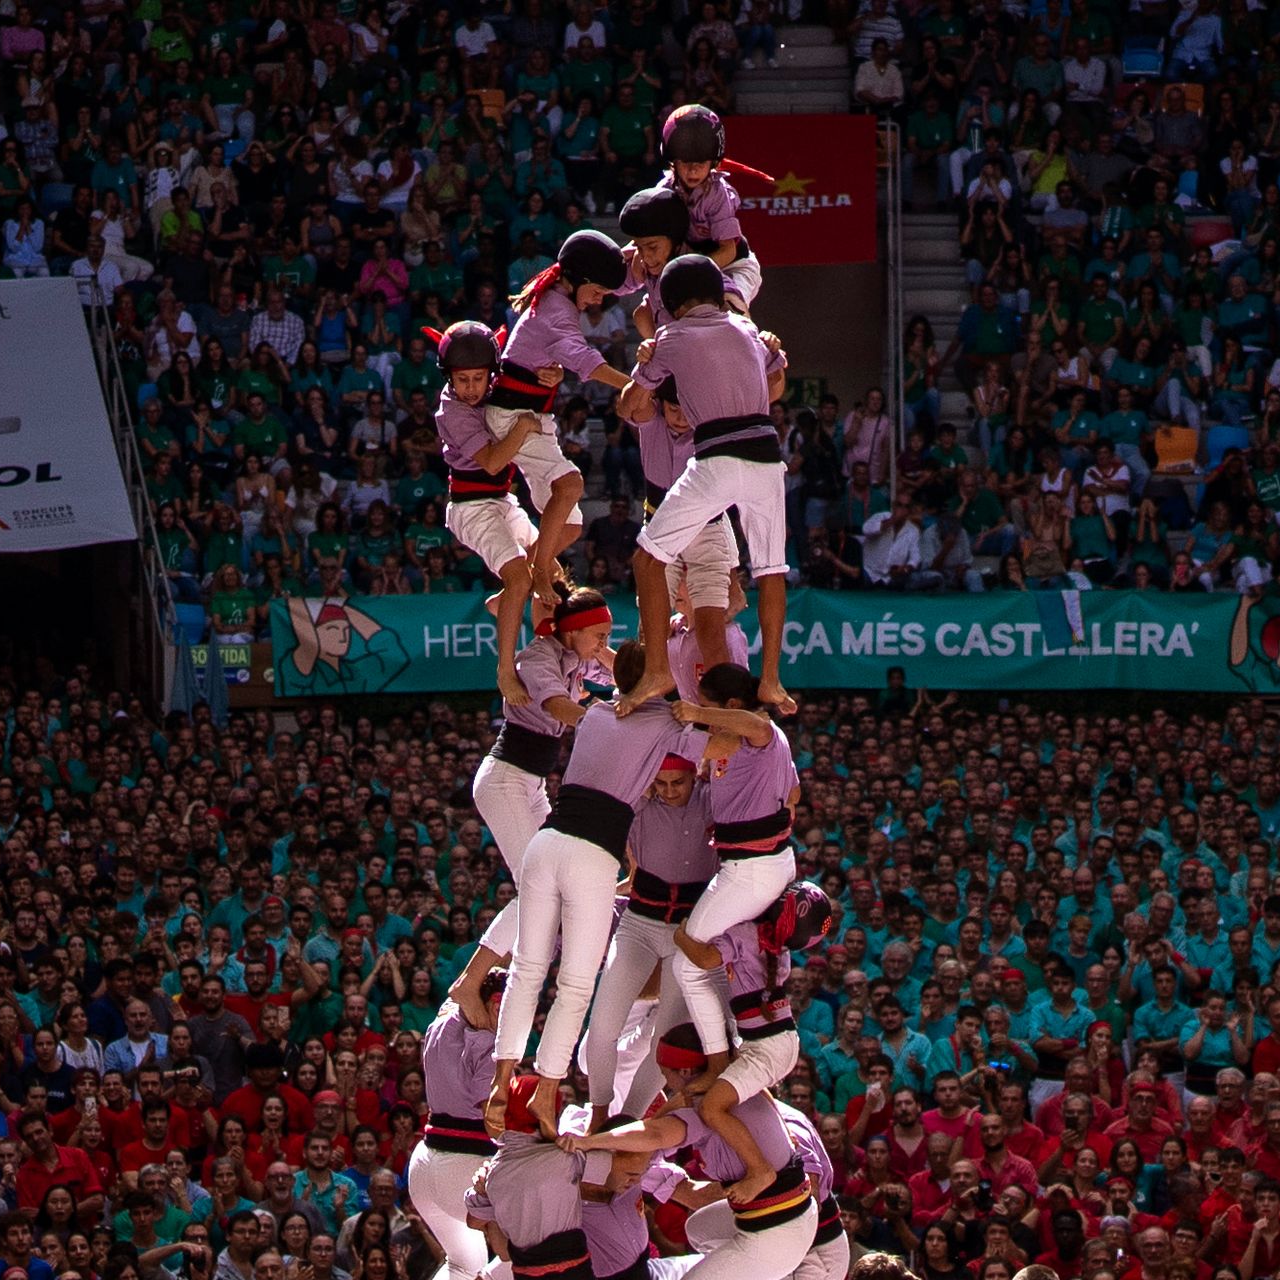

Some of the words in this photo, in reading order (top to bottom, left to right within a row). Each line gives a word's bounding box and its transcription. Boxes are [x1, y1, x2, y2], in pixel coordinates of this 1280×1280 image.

[739, 194, 852, 210] STRELLA
[768, 208, 812, 216] DAMM
[12, 504, 72, 517] CONCURS
[14, 511, 74, 523] CASTELLS
[841, 612, 926, 657] MÉS
[190, 649, 248, 665] SOTIDA
